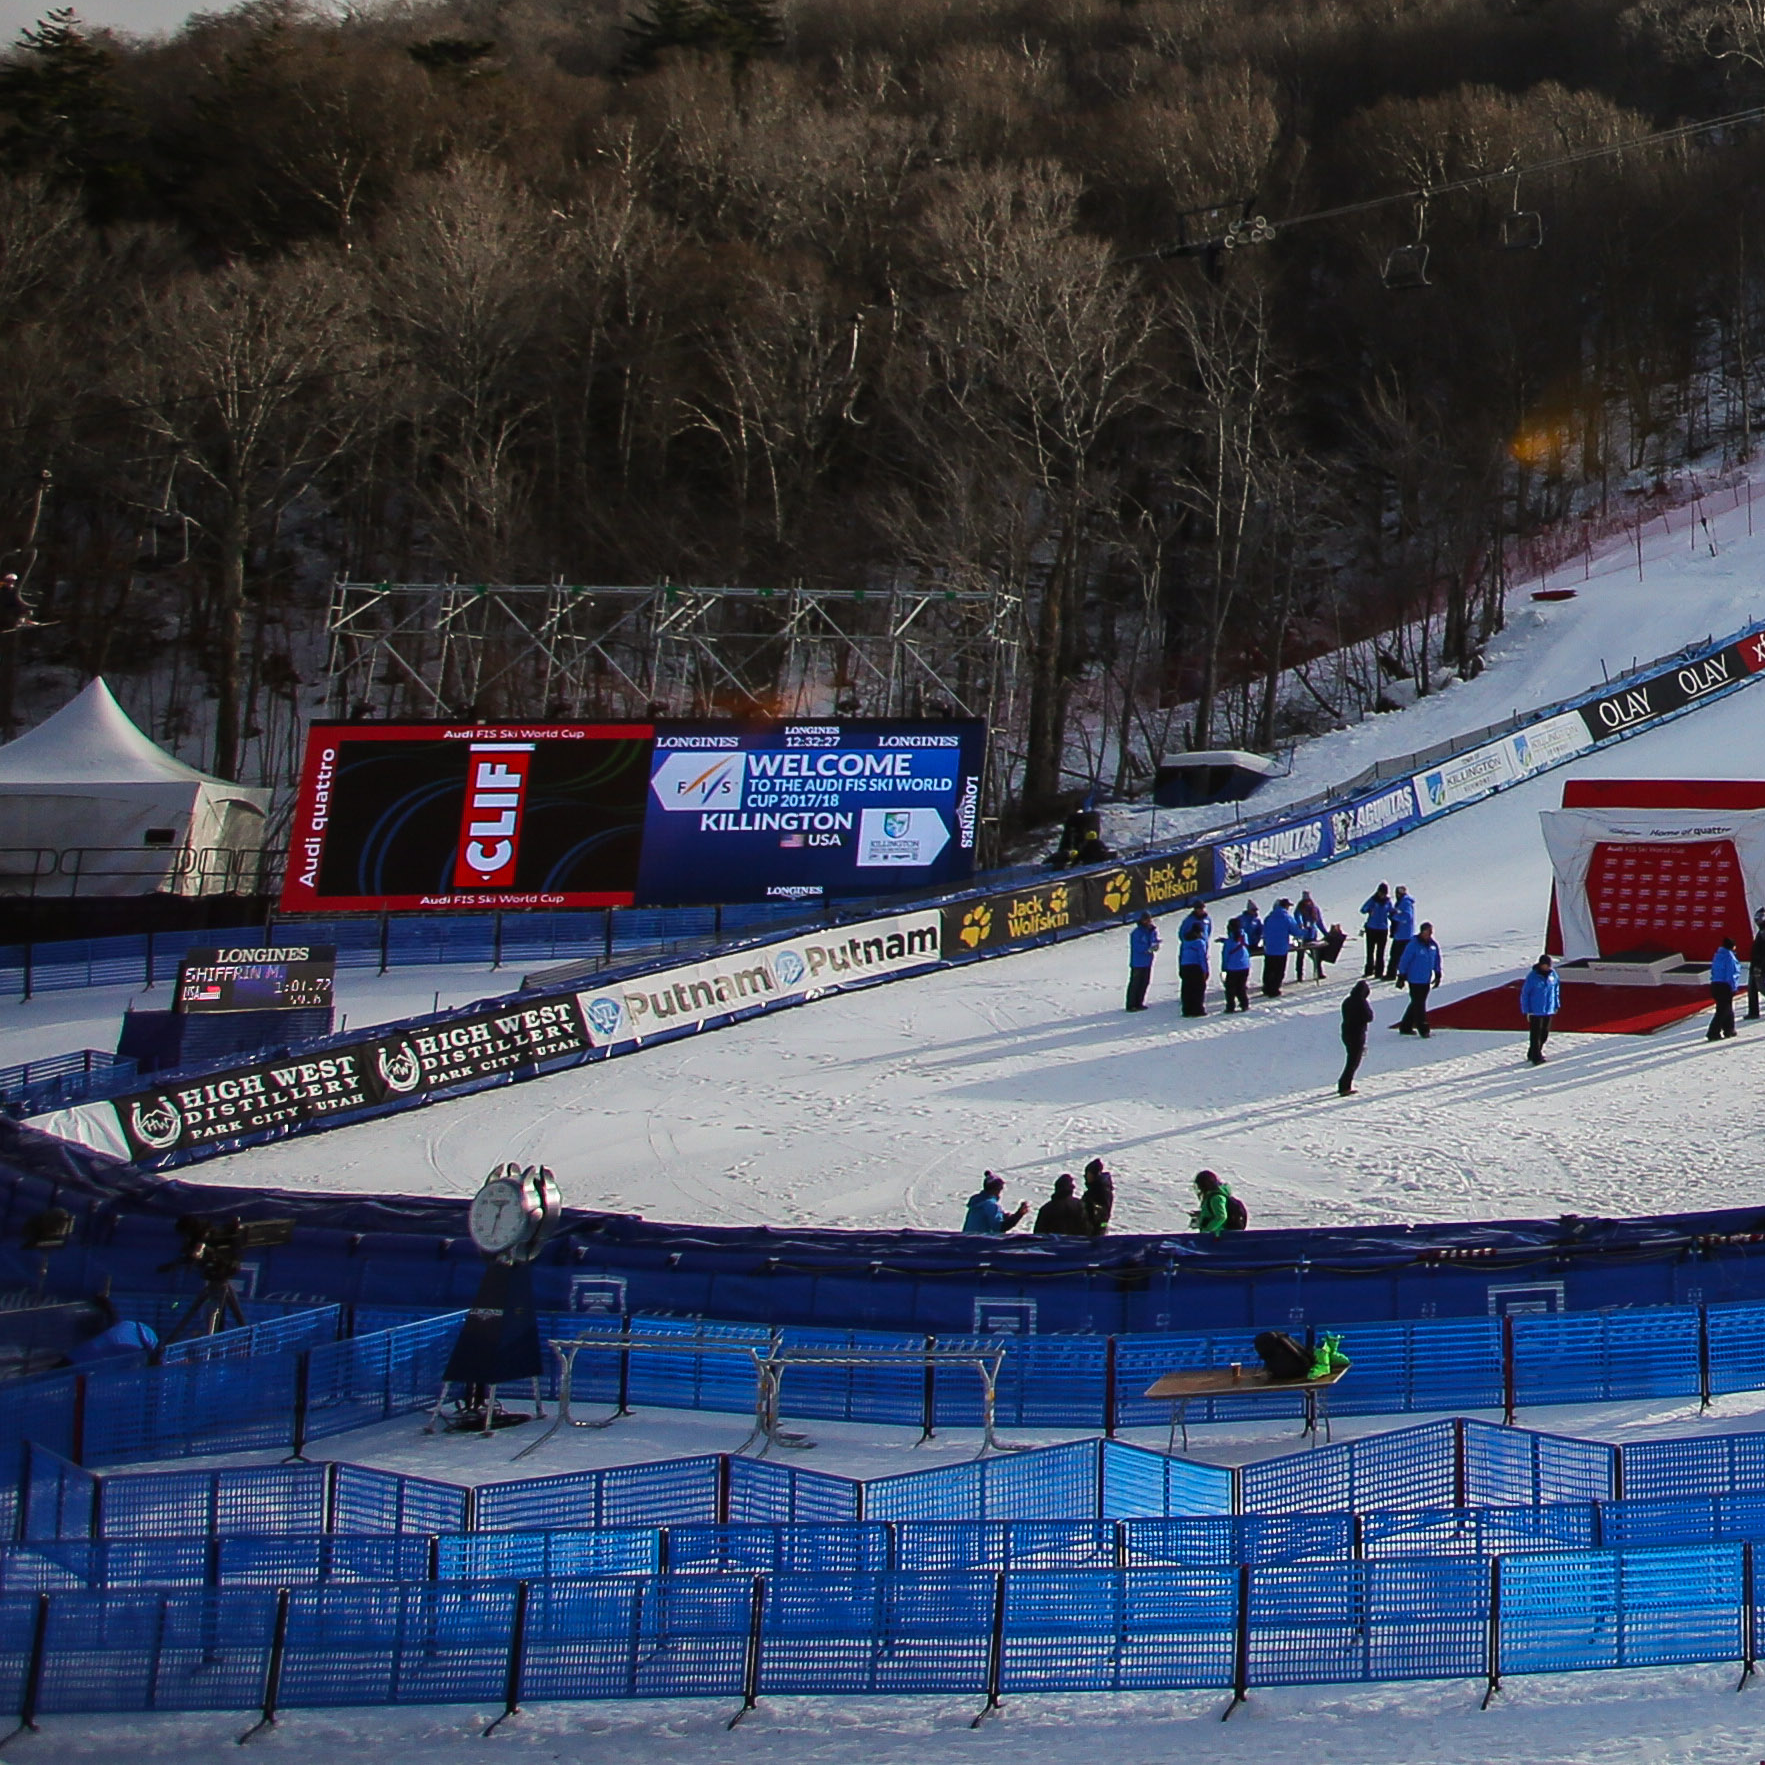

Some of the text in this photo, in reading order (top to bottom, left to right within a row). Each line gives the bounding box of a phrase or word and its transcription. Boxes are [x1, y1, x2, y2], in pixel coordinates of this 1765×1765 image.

[1678, 654, 1729, 695] OLAY
[1599, 687, 1651, 727] OLAY
[443, 729, 585, 739] Audi FIS Ski World Cup
[657, 737, 739, 748] LONGINES
[785, 726, 839, 735] LONGINES
[785, 736, 840, 747] 12:32:27
[878, 736, 959, 747] LONGINES
[748, 753, 913, 776] WELCOME
[1446, 756, 1501, 786] KILLINGTON
[749, 778, 952, 792] TO THE AUDI FIS SKI WORLD
[747, 794, 839, 808] CUP 2017/18
[961, 775, 979, 848] LONGINES
[1347, 785, 1413, 829] LAGUNITAS
[299, 747, 335, 888] Audi quattro
[466, 762, 522, 872] CLIF
[700, 812, 853, 831] KILLINGTON
[808, 834, 841, 846] USA
[1241, 821, 1323, 866] LAGUNITAS
[1145, 862, 1175, 886] Jack
[420, 894, 564, 904] Audi FIS Ski World Cup
[766, 886, 823, 895] LONGINES
[1145, 876, 1198, 912] Wolfskin
[1007, 894, 1044, 920] Jack
[1007, 910, 1070, 939] Wolfskin
[216, 947, 309, 963] LONGINES
[804, 923, 938, 978] Putnam
[185, 965, 261, 983] SHIFFRIN
[624, 962, 775, 1026] Putnam
[415, 1003, 571, 1056] HIGH WEST
[421, 1021, 576, 1071] DISTILLERY
[428, 1037, 581, 1085] PARK CITY UTAH
[177, 1055, 356, 1109] HIGH WEST
[184, 1075, 361, 1125] DISTILLERY
[192, 1093, 365, 1140] PARK CITY UTAH
